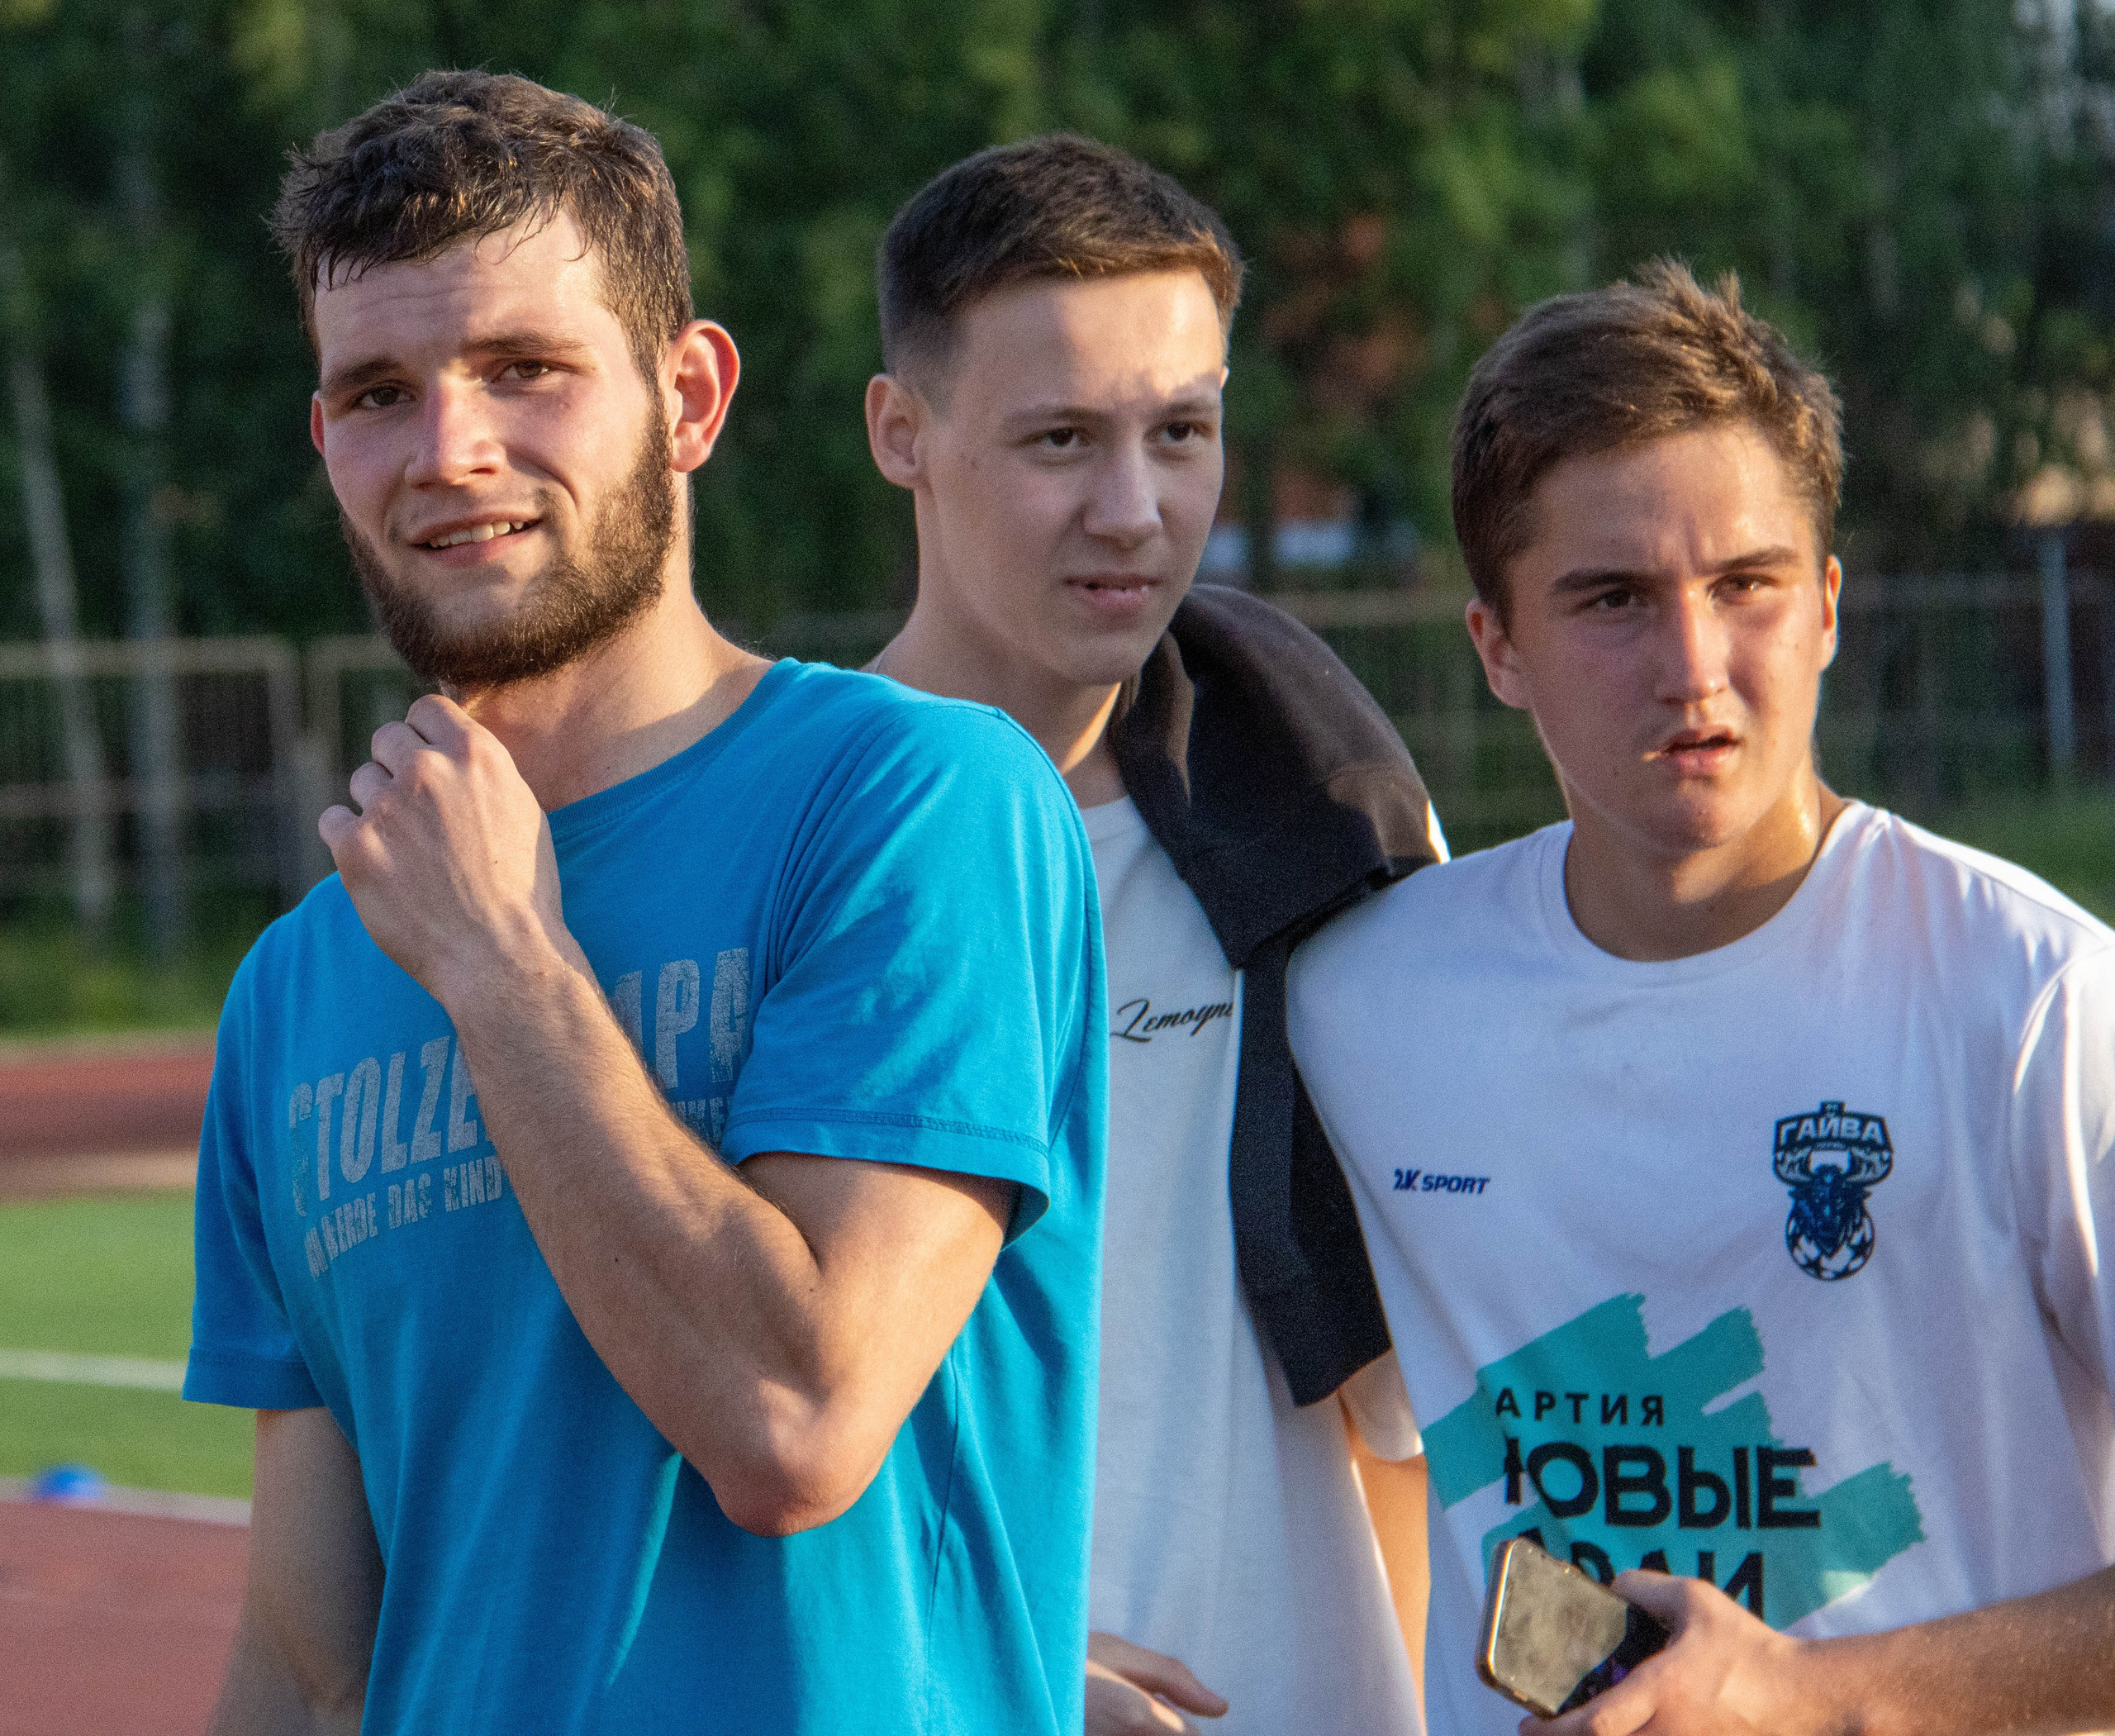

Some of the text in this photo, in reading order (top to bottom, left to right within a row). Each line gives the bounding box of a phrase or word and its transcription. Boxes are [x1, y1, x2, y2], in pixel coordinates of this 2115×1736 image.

[289, 1036, 492, 1217] STOLZE
[388, 1173, 432, 1229] DAS
[444, 1155, 502, 1212] KIND
[1422, 1173, 1490, 1194] SPORT
